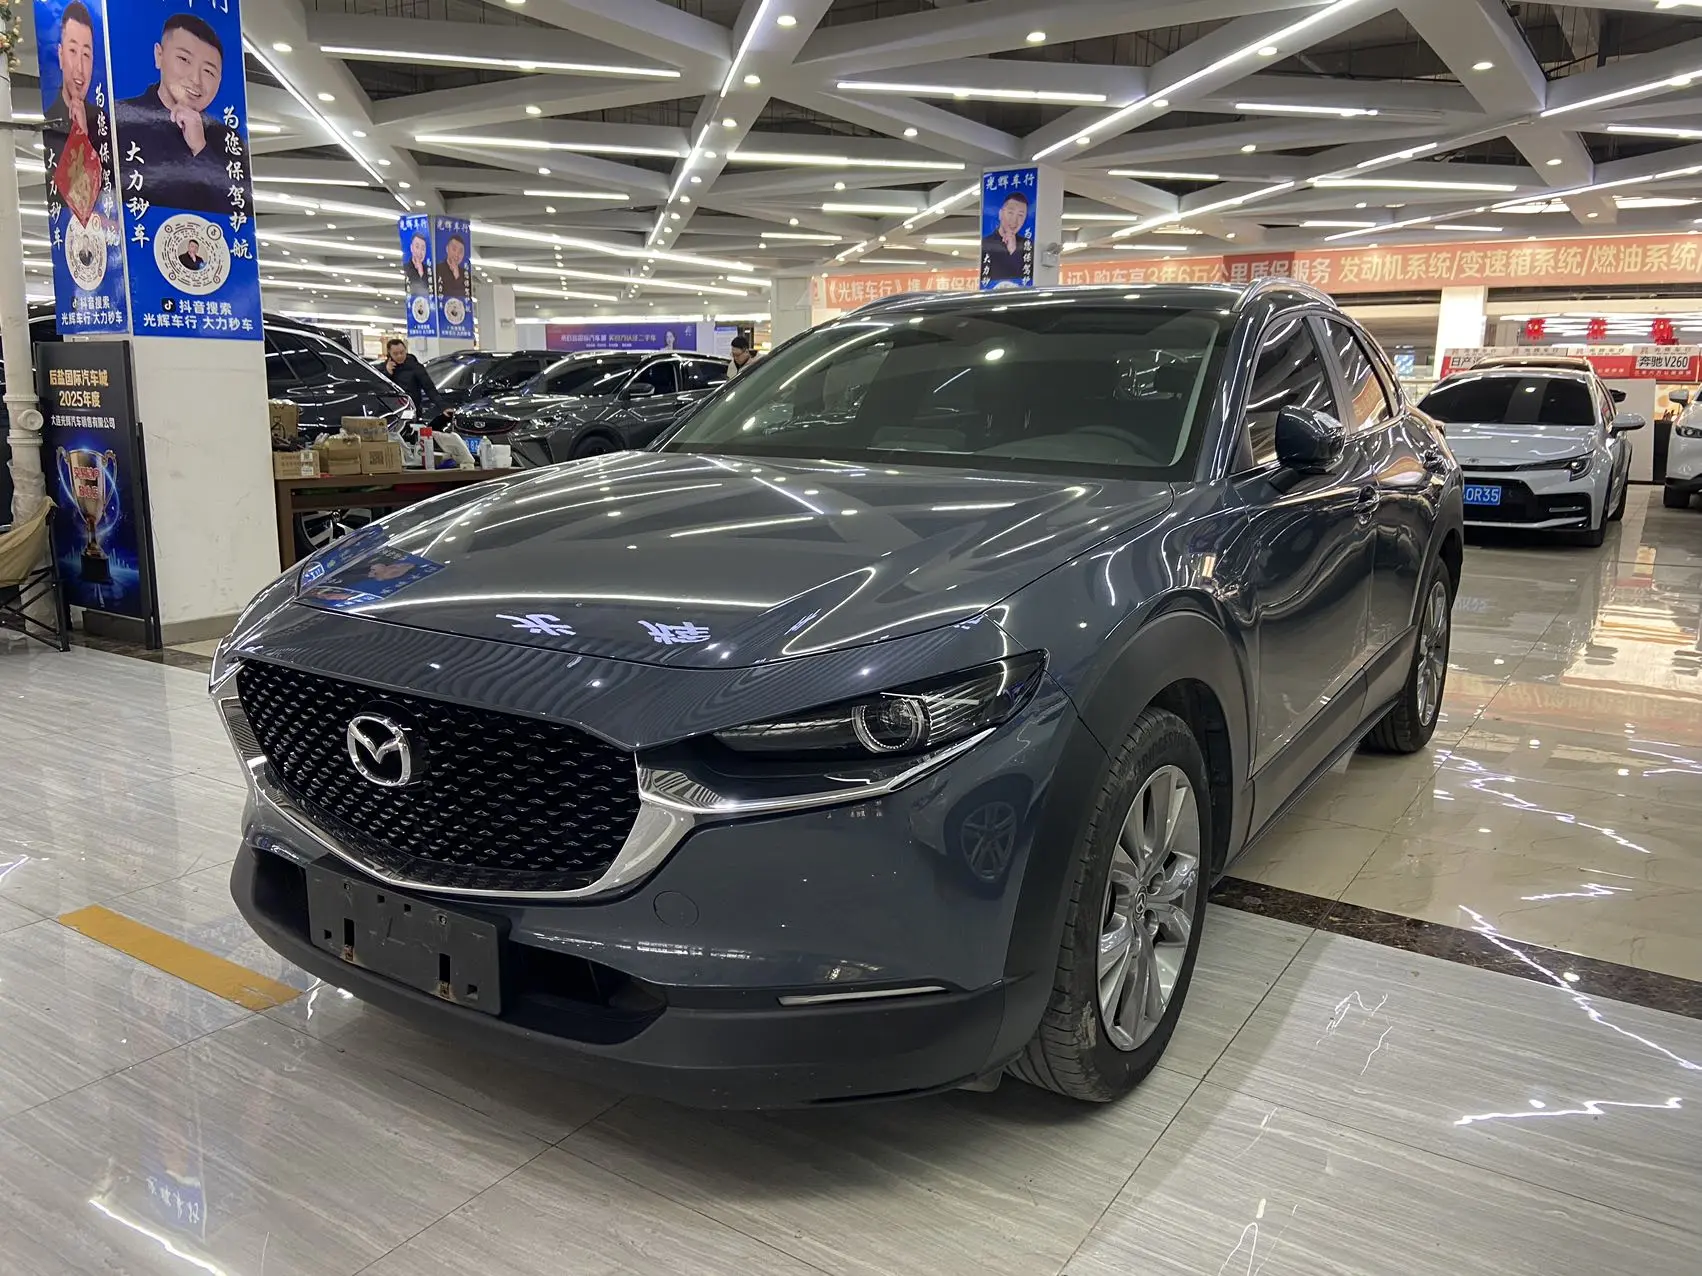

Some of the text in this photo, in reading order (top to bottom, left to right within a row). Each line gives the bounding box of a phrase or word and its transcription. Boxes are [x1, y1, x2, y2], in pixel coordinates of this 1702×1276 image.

[223, 104, 253, 260] 为您保驾护航
[986, 172, 1035, 190] 光辉车行
[125, 140, 151, 249] 大力秒车
[80, 295, 110, 310] 抖音搜索
[179, 299, 232, 316] 抖音搜索
[61, 311, 123, 326] 光辉车行 大力秒车
[143, 313, 254, 332] 光辉车行 大力秒车
[49, 368, 109, 387] 后盐国际汽车城
[59, 390, 101, 408] 2025年度
[1463, 487, 1499, 502] 0R35
